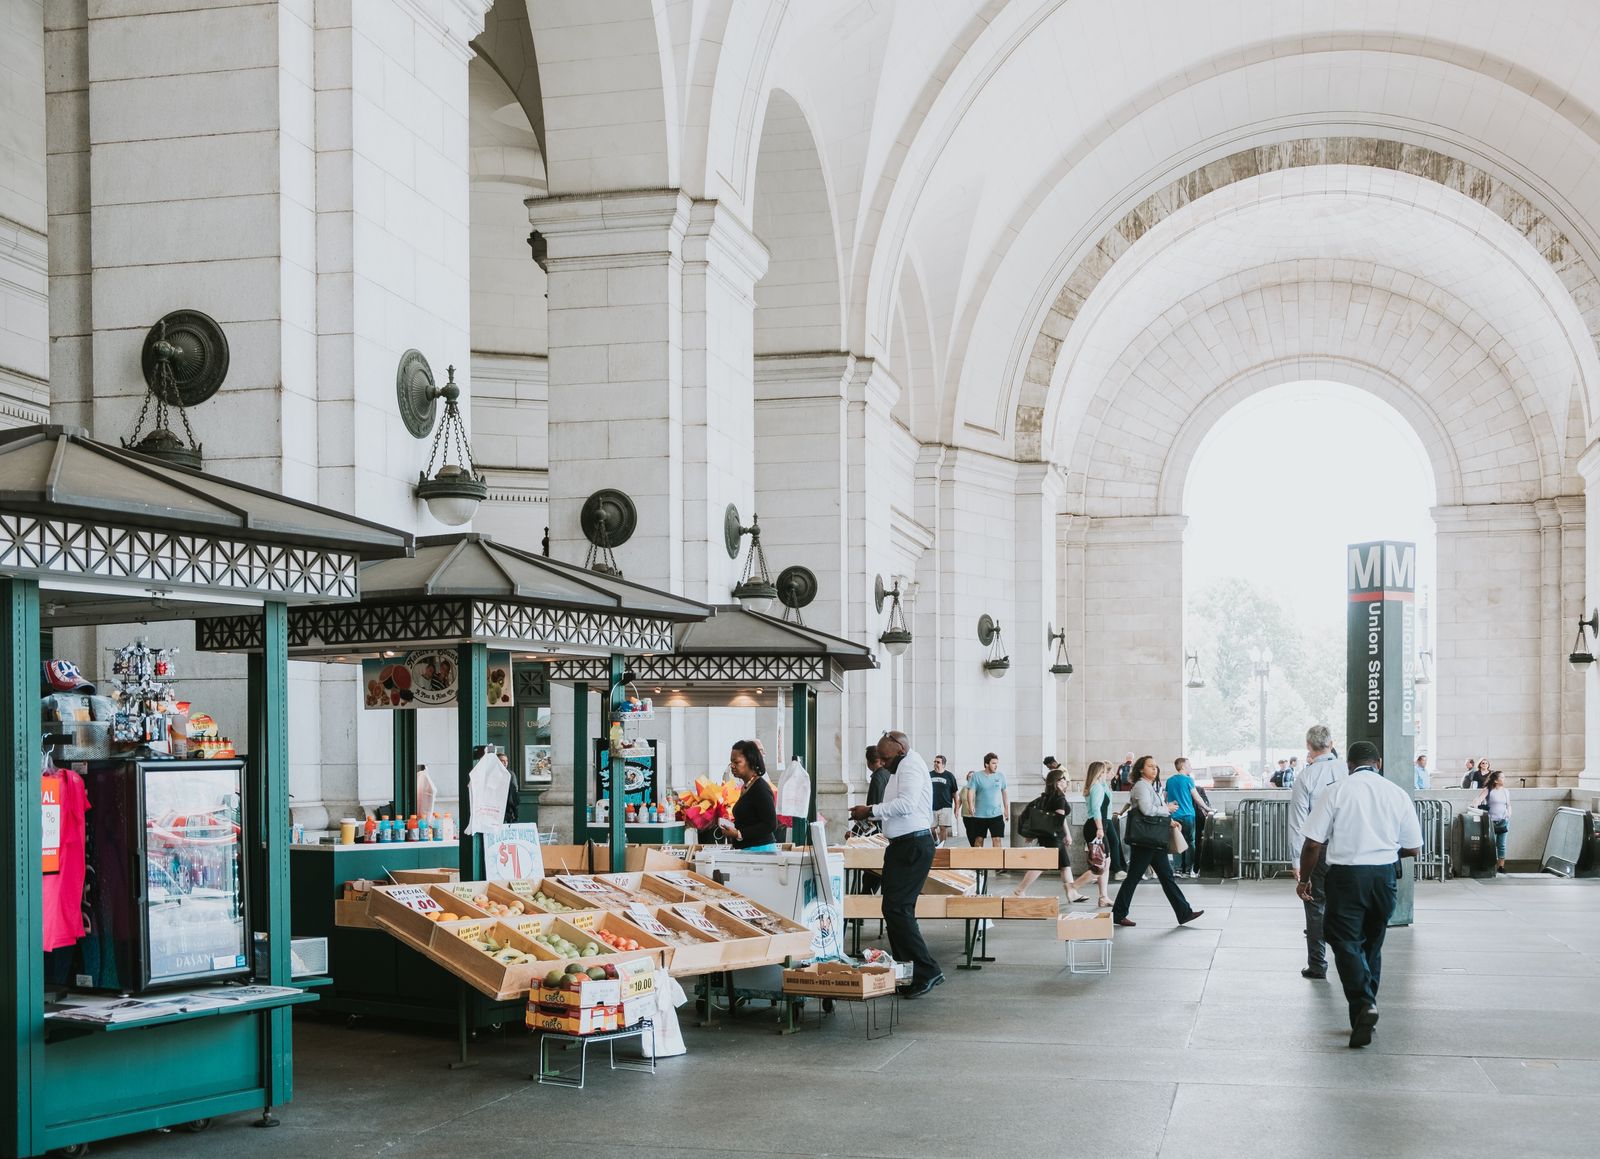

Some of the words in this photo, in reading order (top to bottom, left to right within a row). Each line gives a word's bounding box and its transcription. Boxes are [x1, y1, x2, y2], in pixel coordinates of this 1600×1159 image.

[1349, 545, 1381, 590] M
[1385, 544, 1415, 588] M
[1368, 602, 1381, 655] Union
[1403, 603, 1414, 655] Union
[1368, 660, 1381, 724] Station
[1403, 662, 1414, 723] Station
[41, 791, 56, 804] AL
[498, 842, 522, 880] $1
[392, 889, 425, 897] SPECIAL
[634, 977, 652, 992] 10.00
